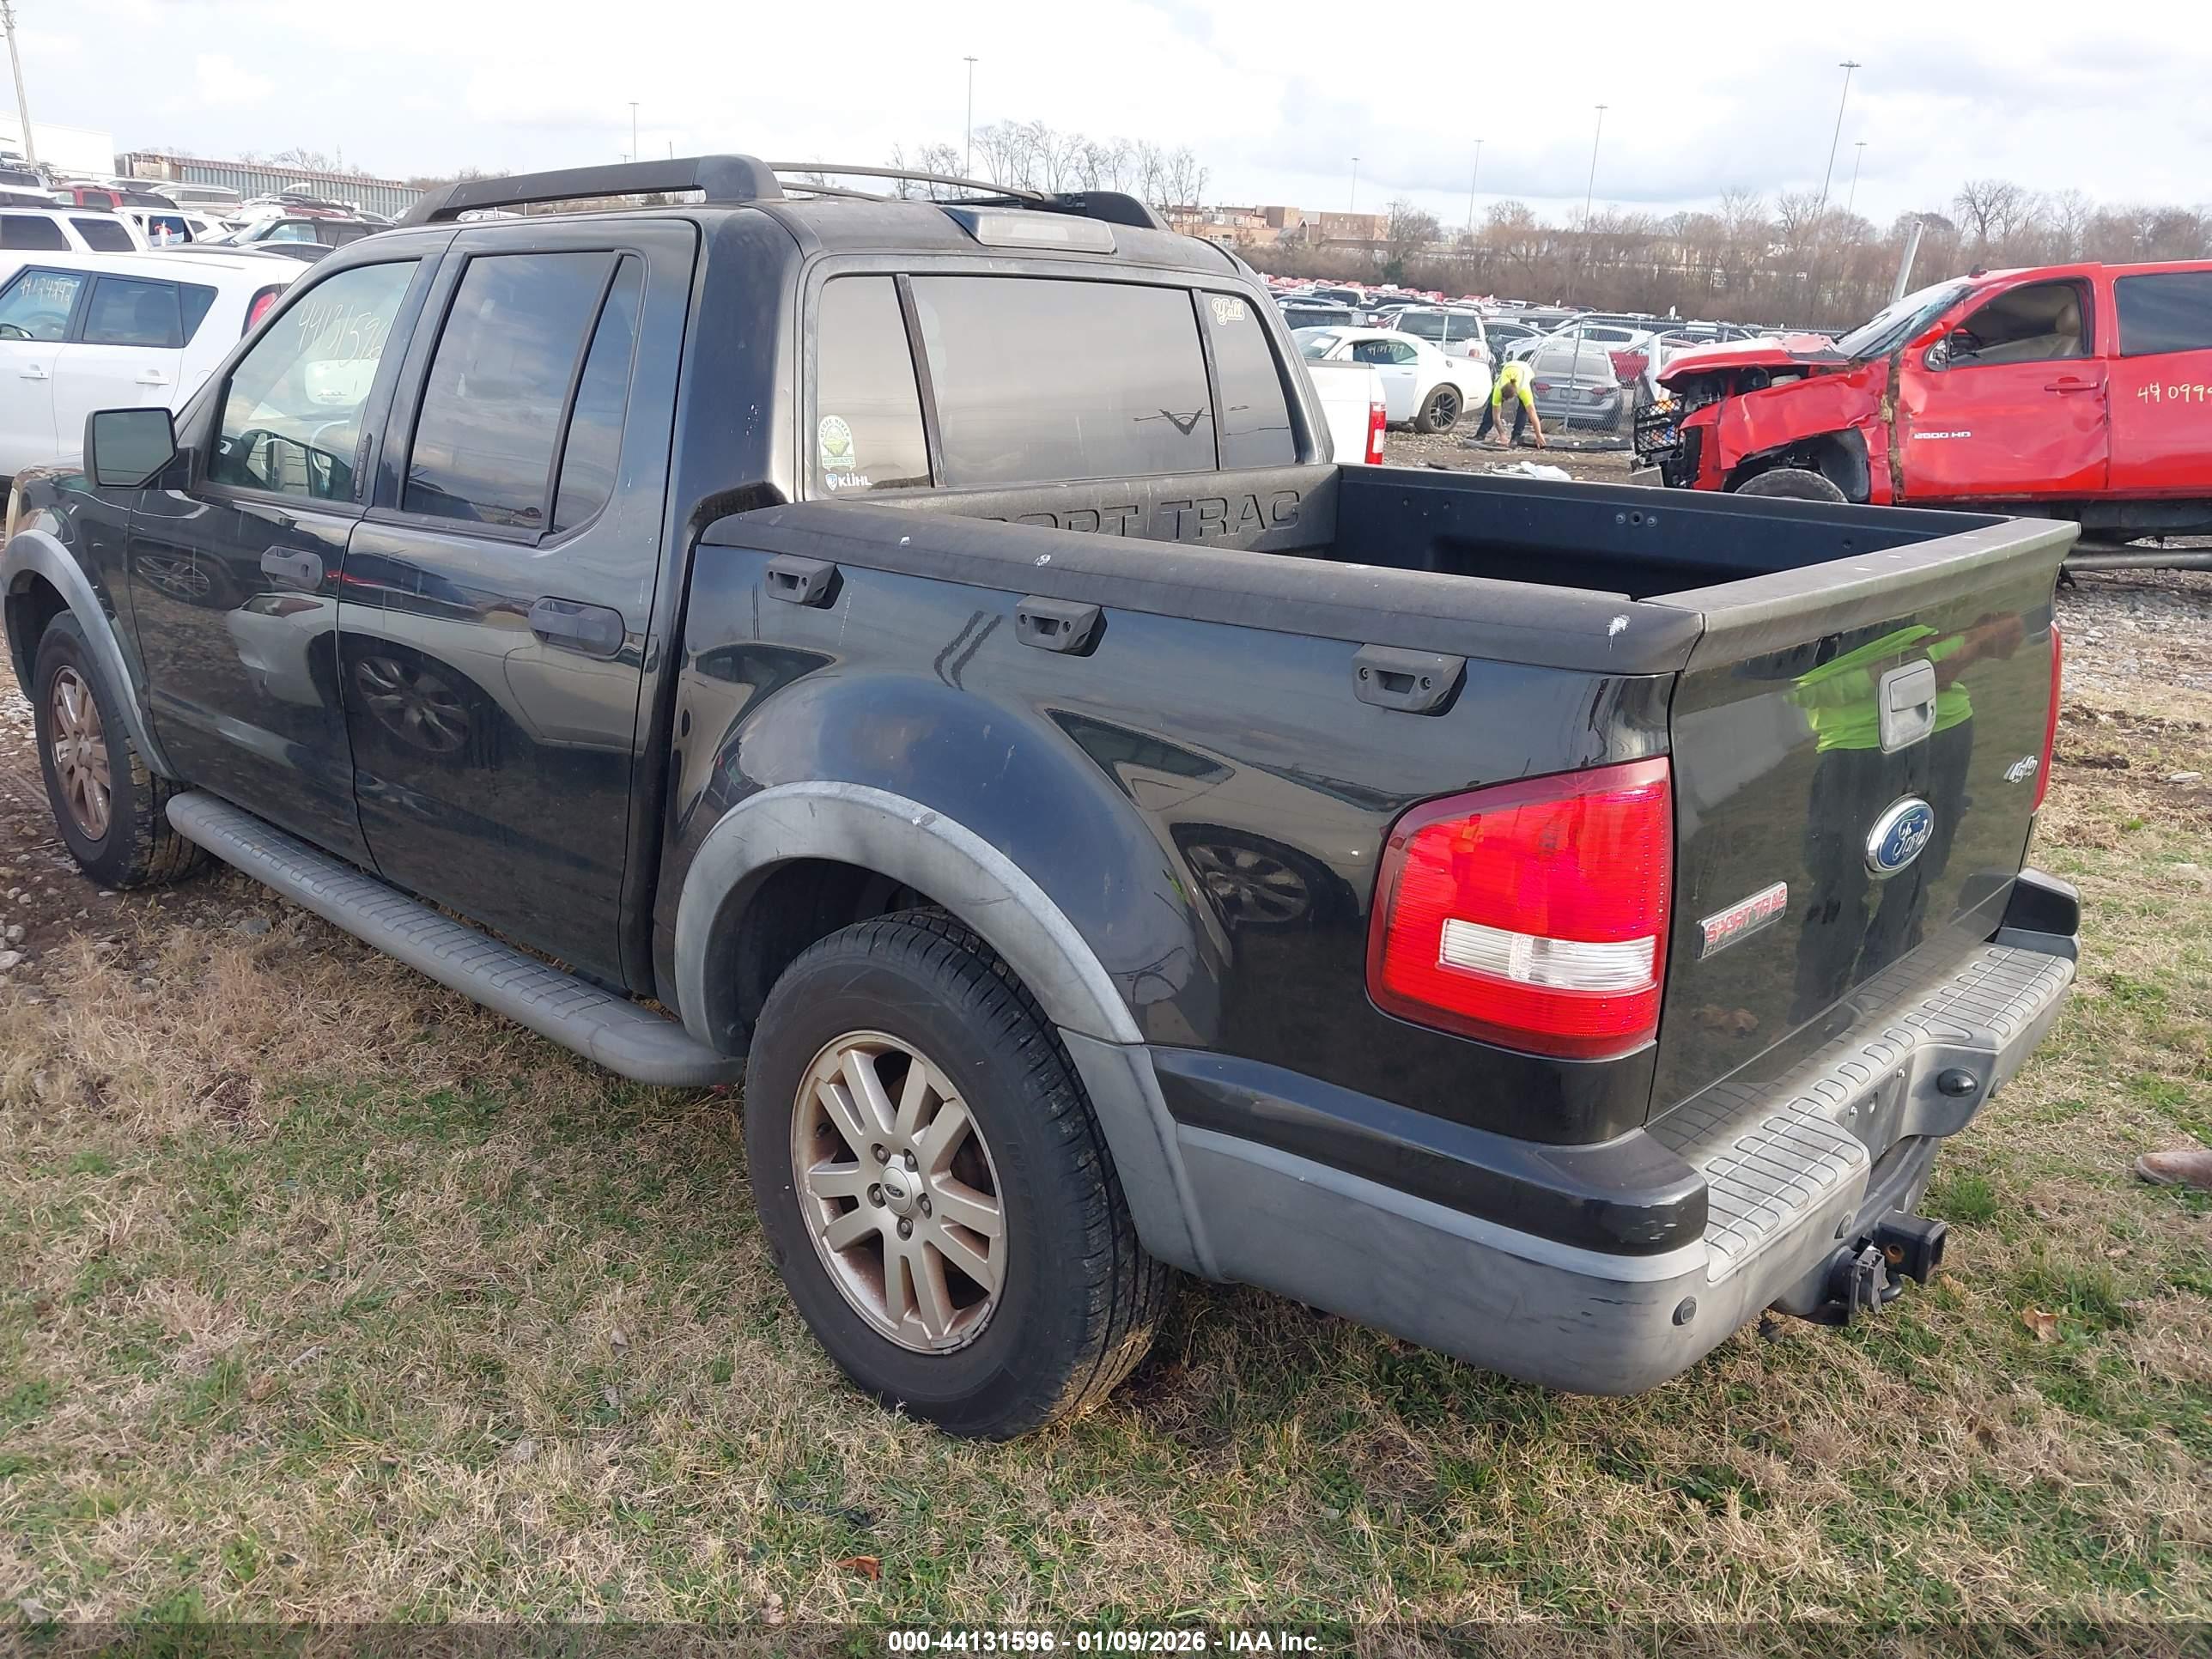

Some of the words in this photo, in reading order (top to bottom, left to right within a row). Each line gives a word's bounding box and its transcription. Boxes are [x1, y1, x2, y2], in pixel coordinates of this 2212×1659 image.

[1160, 490, 1300, 543] TRAC
[1892, 814, 1929, 861] Ford
[1705, 904, 1752, 944] SPORT
[1753, 887, 1787, 921] TRAC
